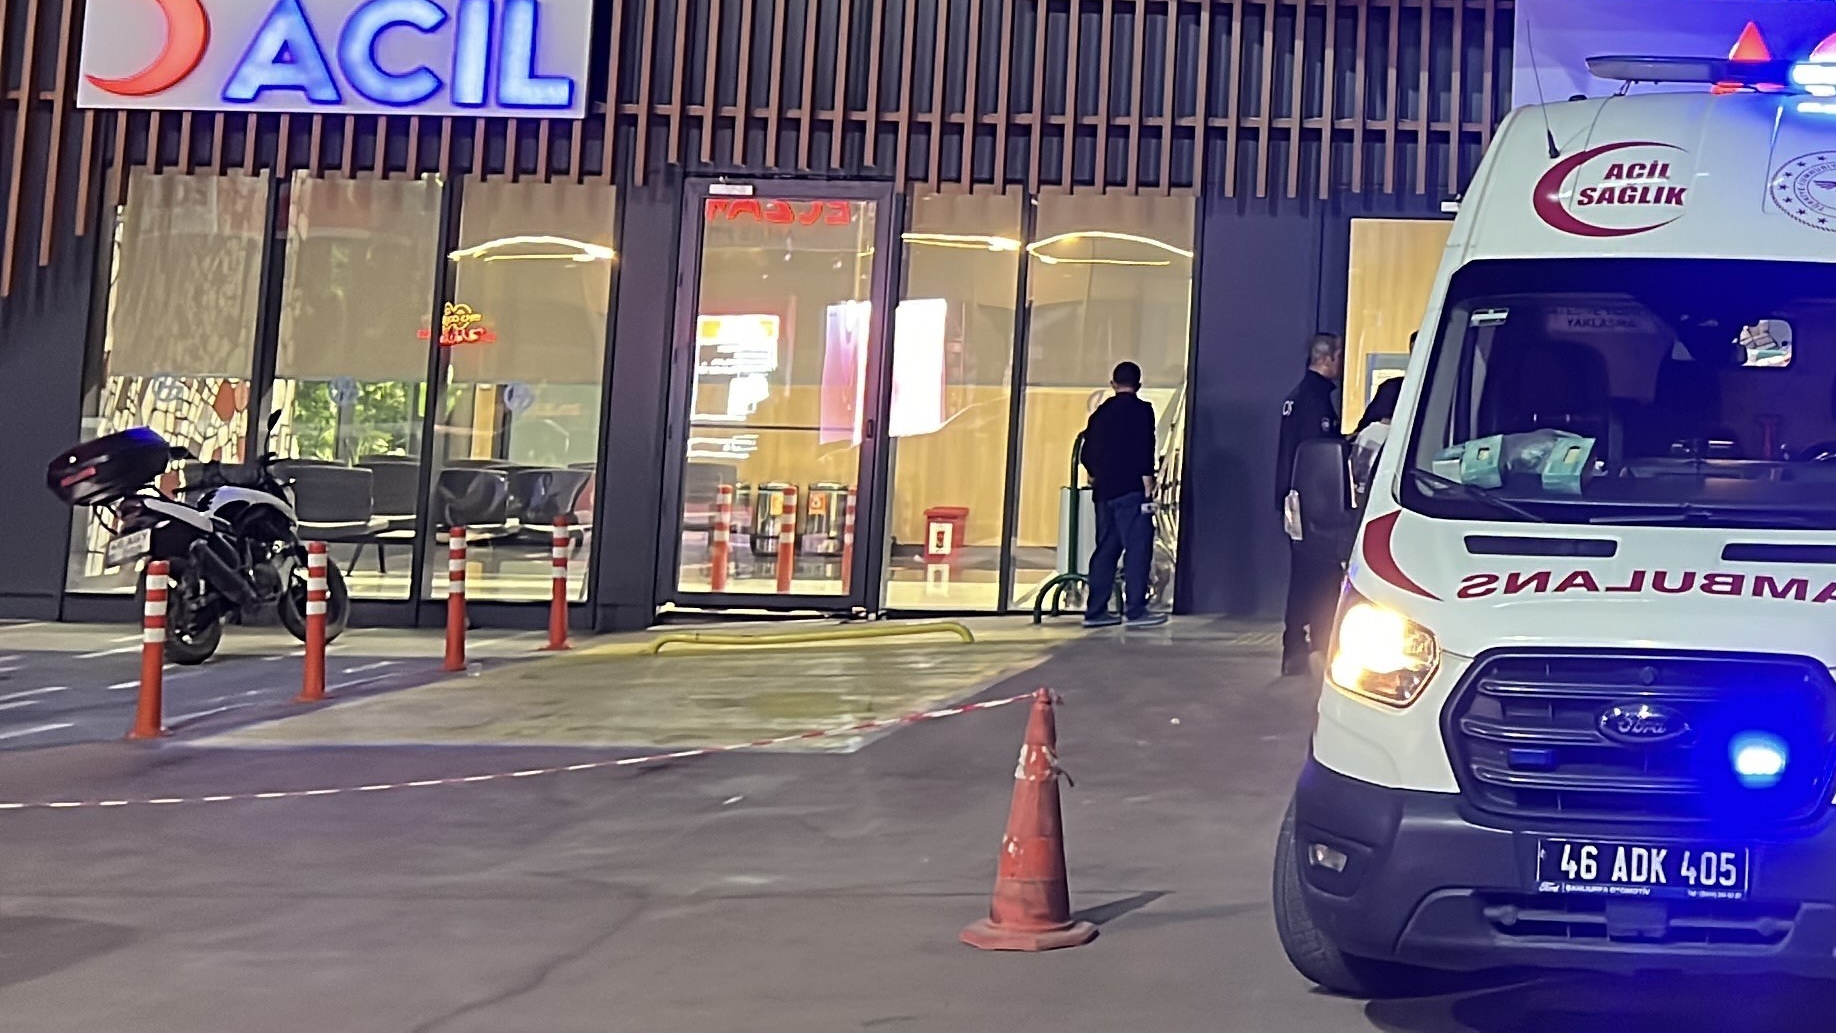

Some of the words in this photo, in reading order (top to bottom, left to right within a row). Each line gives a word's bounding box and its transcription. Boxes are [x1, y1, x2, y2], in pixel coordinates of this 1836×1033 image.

[1604, 160, 1670, 180] ACİL
[1577, 183, 1688, 206] SAĞLIK
[1560, 844, 1598, 880] 46
[1611, 846, 1668, 884] ADK
[1681, 851, 1737, 886] 405
